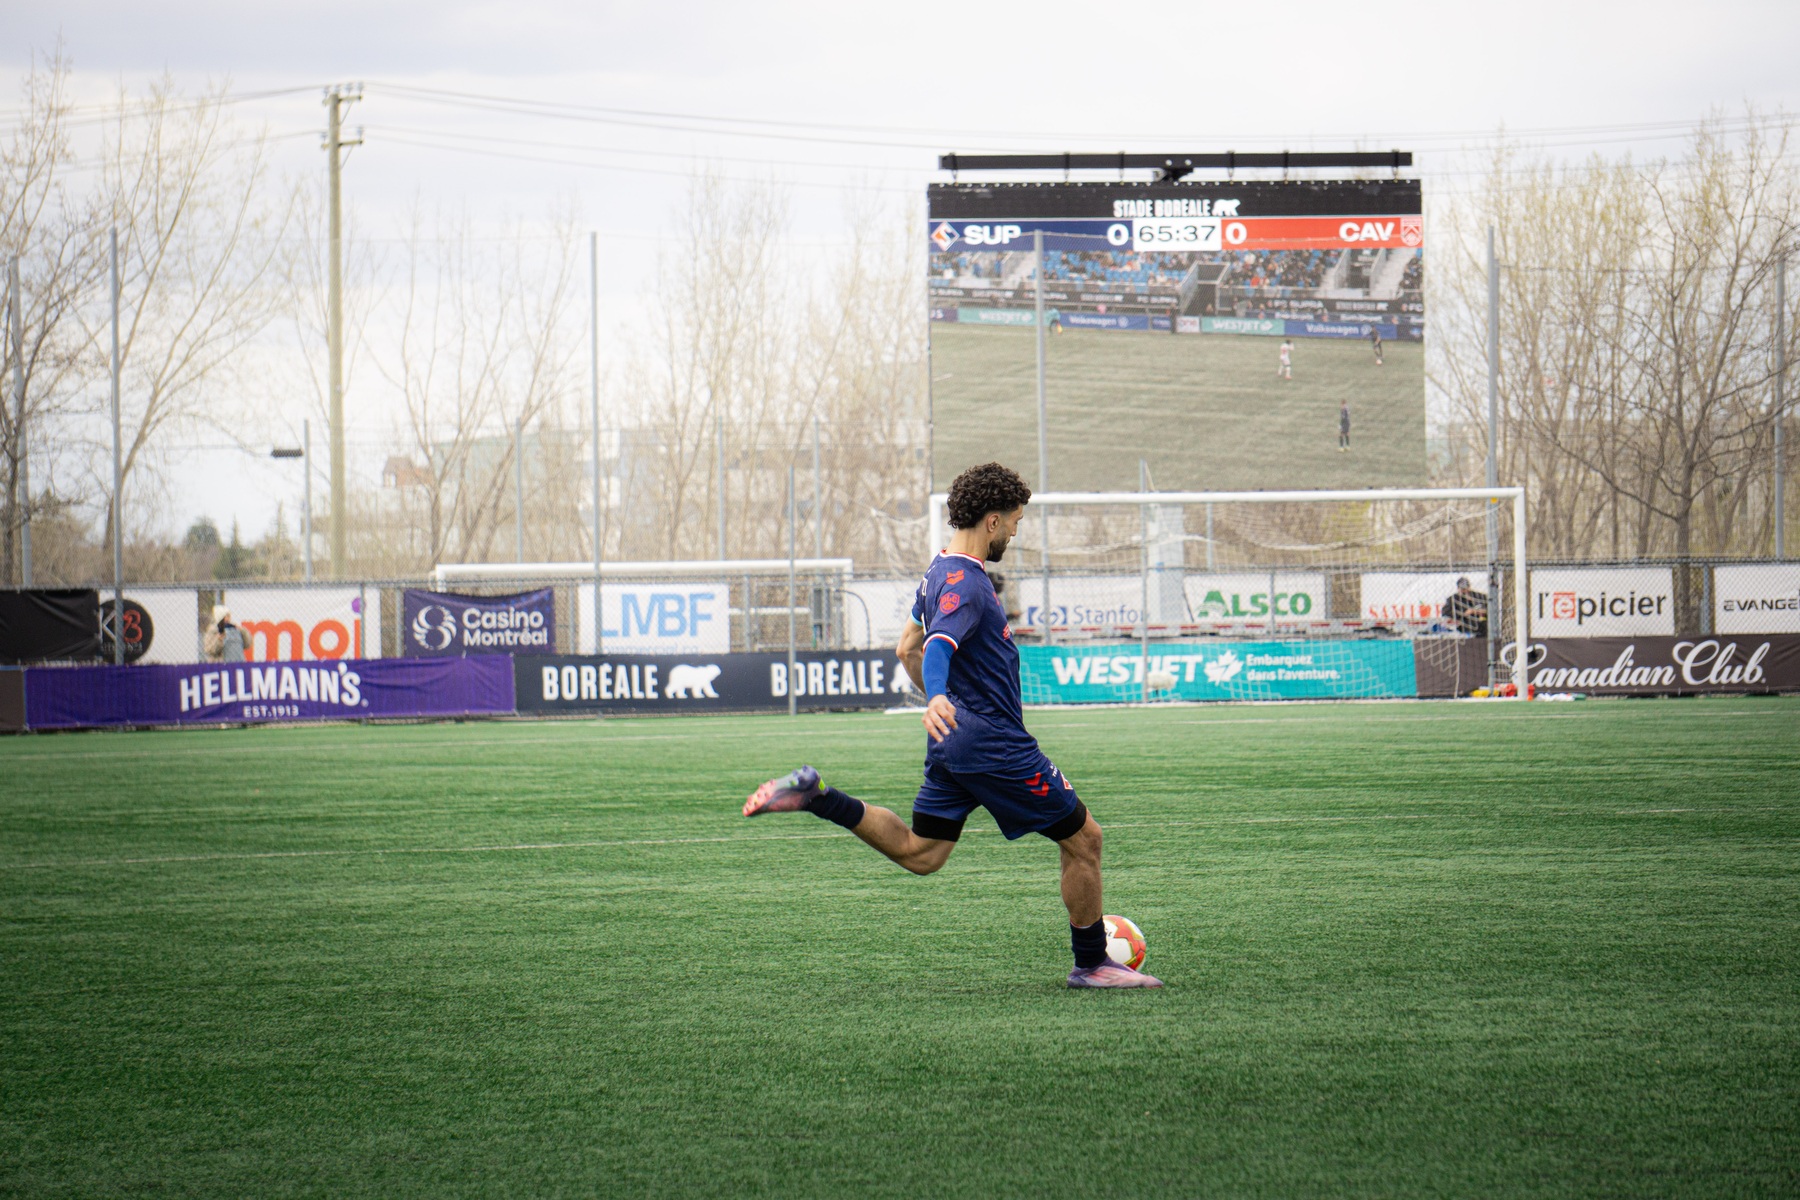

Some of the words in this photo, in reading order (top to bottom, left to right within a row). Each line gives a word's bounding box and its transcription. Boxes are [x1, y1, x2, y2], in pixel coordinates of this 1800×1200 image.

[1113, 199, 1153, 217] STADE
[963, 224, 1022, 246] SUP
[1106, 223, 1130, 247] 0
[1138, 225, 1216, 243] 65:37
[1225, 222, 1248, 245] 0
[1338, 221, 1396, 243] CAV
[1212, 319, 1260, 332] WESTJET
[1305, 322, 1359, 336] Volkswagen
[600, 593, 716, 637] MBF
[1197, 591, 1312, 617] ALSCO
[462, 607, 544, 629] Casino
[242, 597, 362, 662] moi
[463, 627, 548, 646] Montréal
[1051, 654, 1204, 686] WESTJET
[1246, 654, 1313, 669] Embarquez
[1500, 639, 1676, 687] Canadian
[542, 663, 659, 700] BORÉALE
[770, 659, 885, 697] BORÉALE
[1246, 667, 1277, 681] dans
